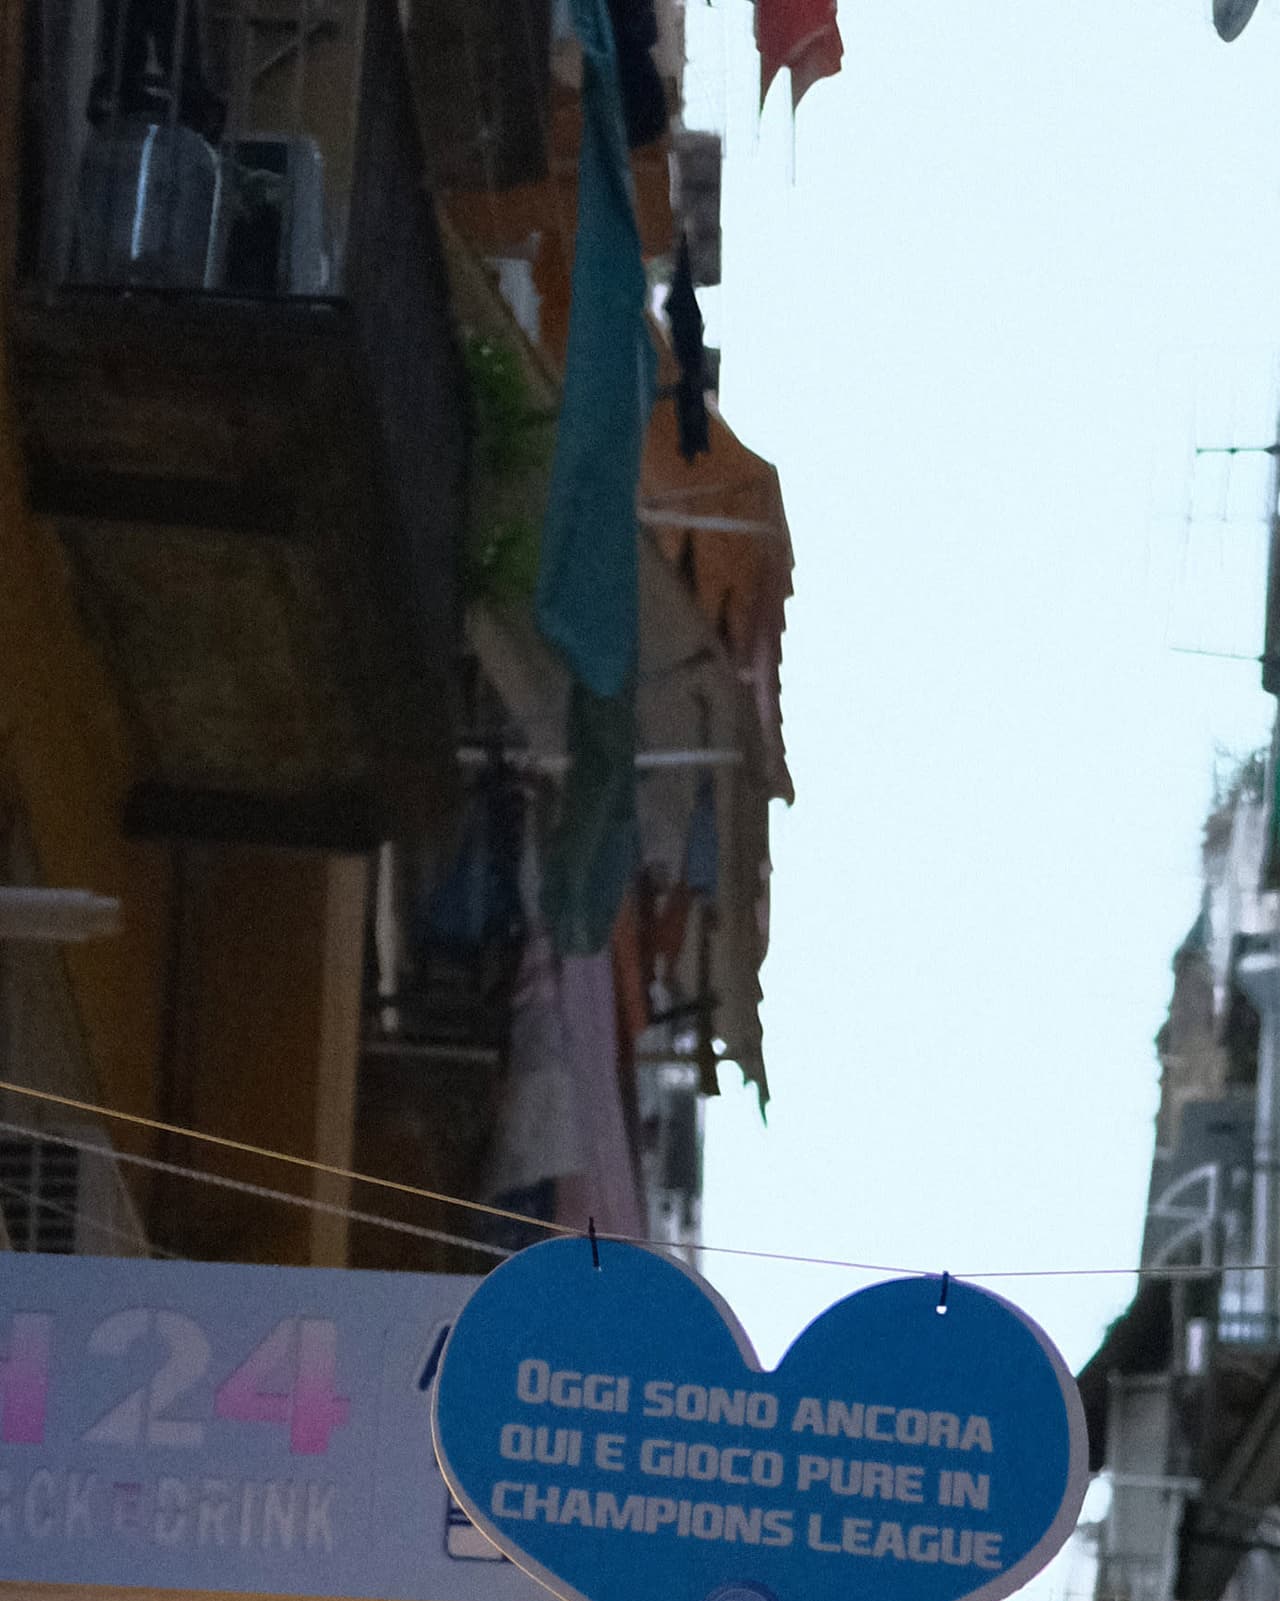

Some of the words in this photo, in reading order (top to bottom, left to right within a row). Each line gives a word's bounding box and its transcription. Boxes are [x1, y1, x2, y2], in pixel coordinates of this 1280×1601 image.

[516, 1358, 629, 1413] OGGI
[642, 1380, 779, 1429] SONO
[791, 1398, 993, 1453] ANCORA
[499, 1423, 581, 1467] QUI
[595, 1434, 626, 1472] E
[640, 1439, 783, 1489] GIOCO
[796, 1455, 924, 1504] PURE
[938, 1469, 991, 1511] IN
[153, 1476, 337, 1552] DRINK
[491, 1480, 794, 1549] CHAMPIONS
[808, 1518, 1003, 1570] LEAGUE
